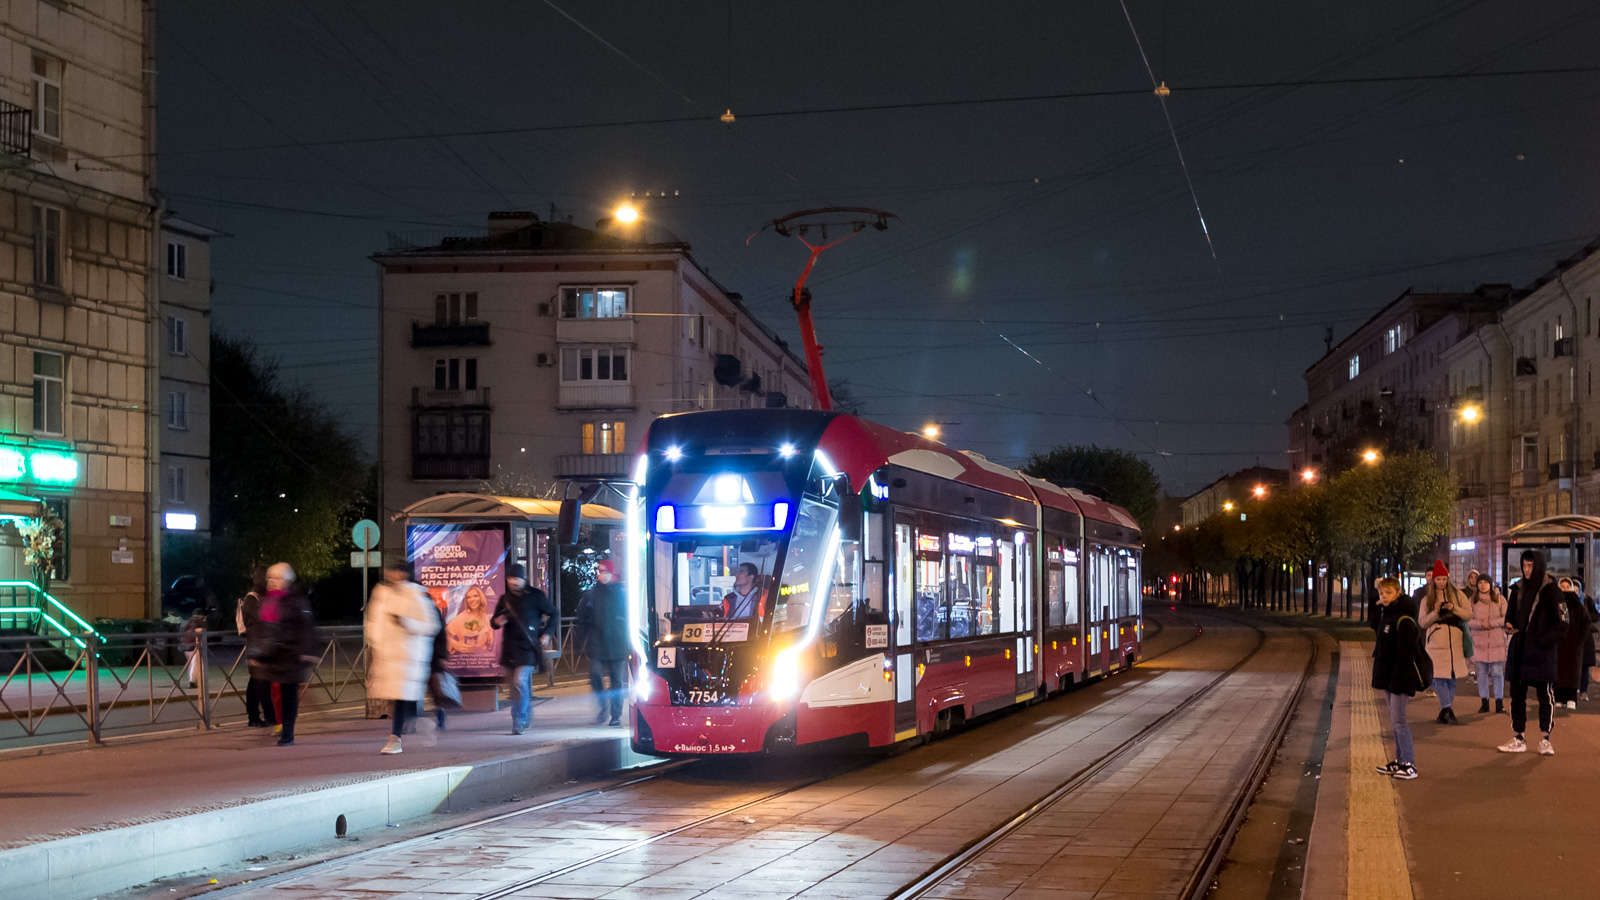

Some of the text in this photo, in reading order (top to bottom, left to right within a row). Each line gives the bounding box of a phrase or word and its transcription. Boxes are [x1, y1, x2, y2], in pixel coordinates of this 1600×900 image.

[421, 579, 490, 587] ОПАЗДЫВАТЬ
[685, 628, 702, 638] 30
[689, 691, 718, 702] 7754
[681, 744, 707, 752] Вынос
[709, 744, 720, 752] 1,5
